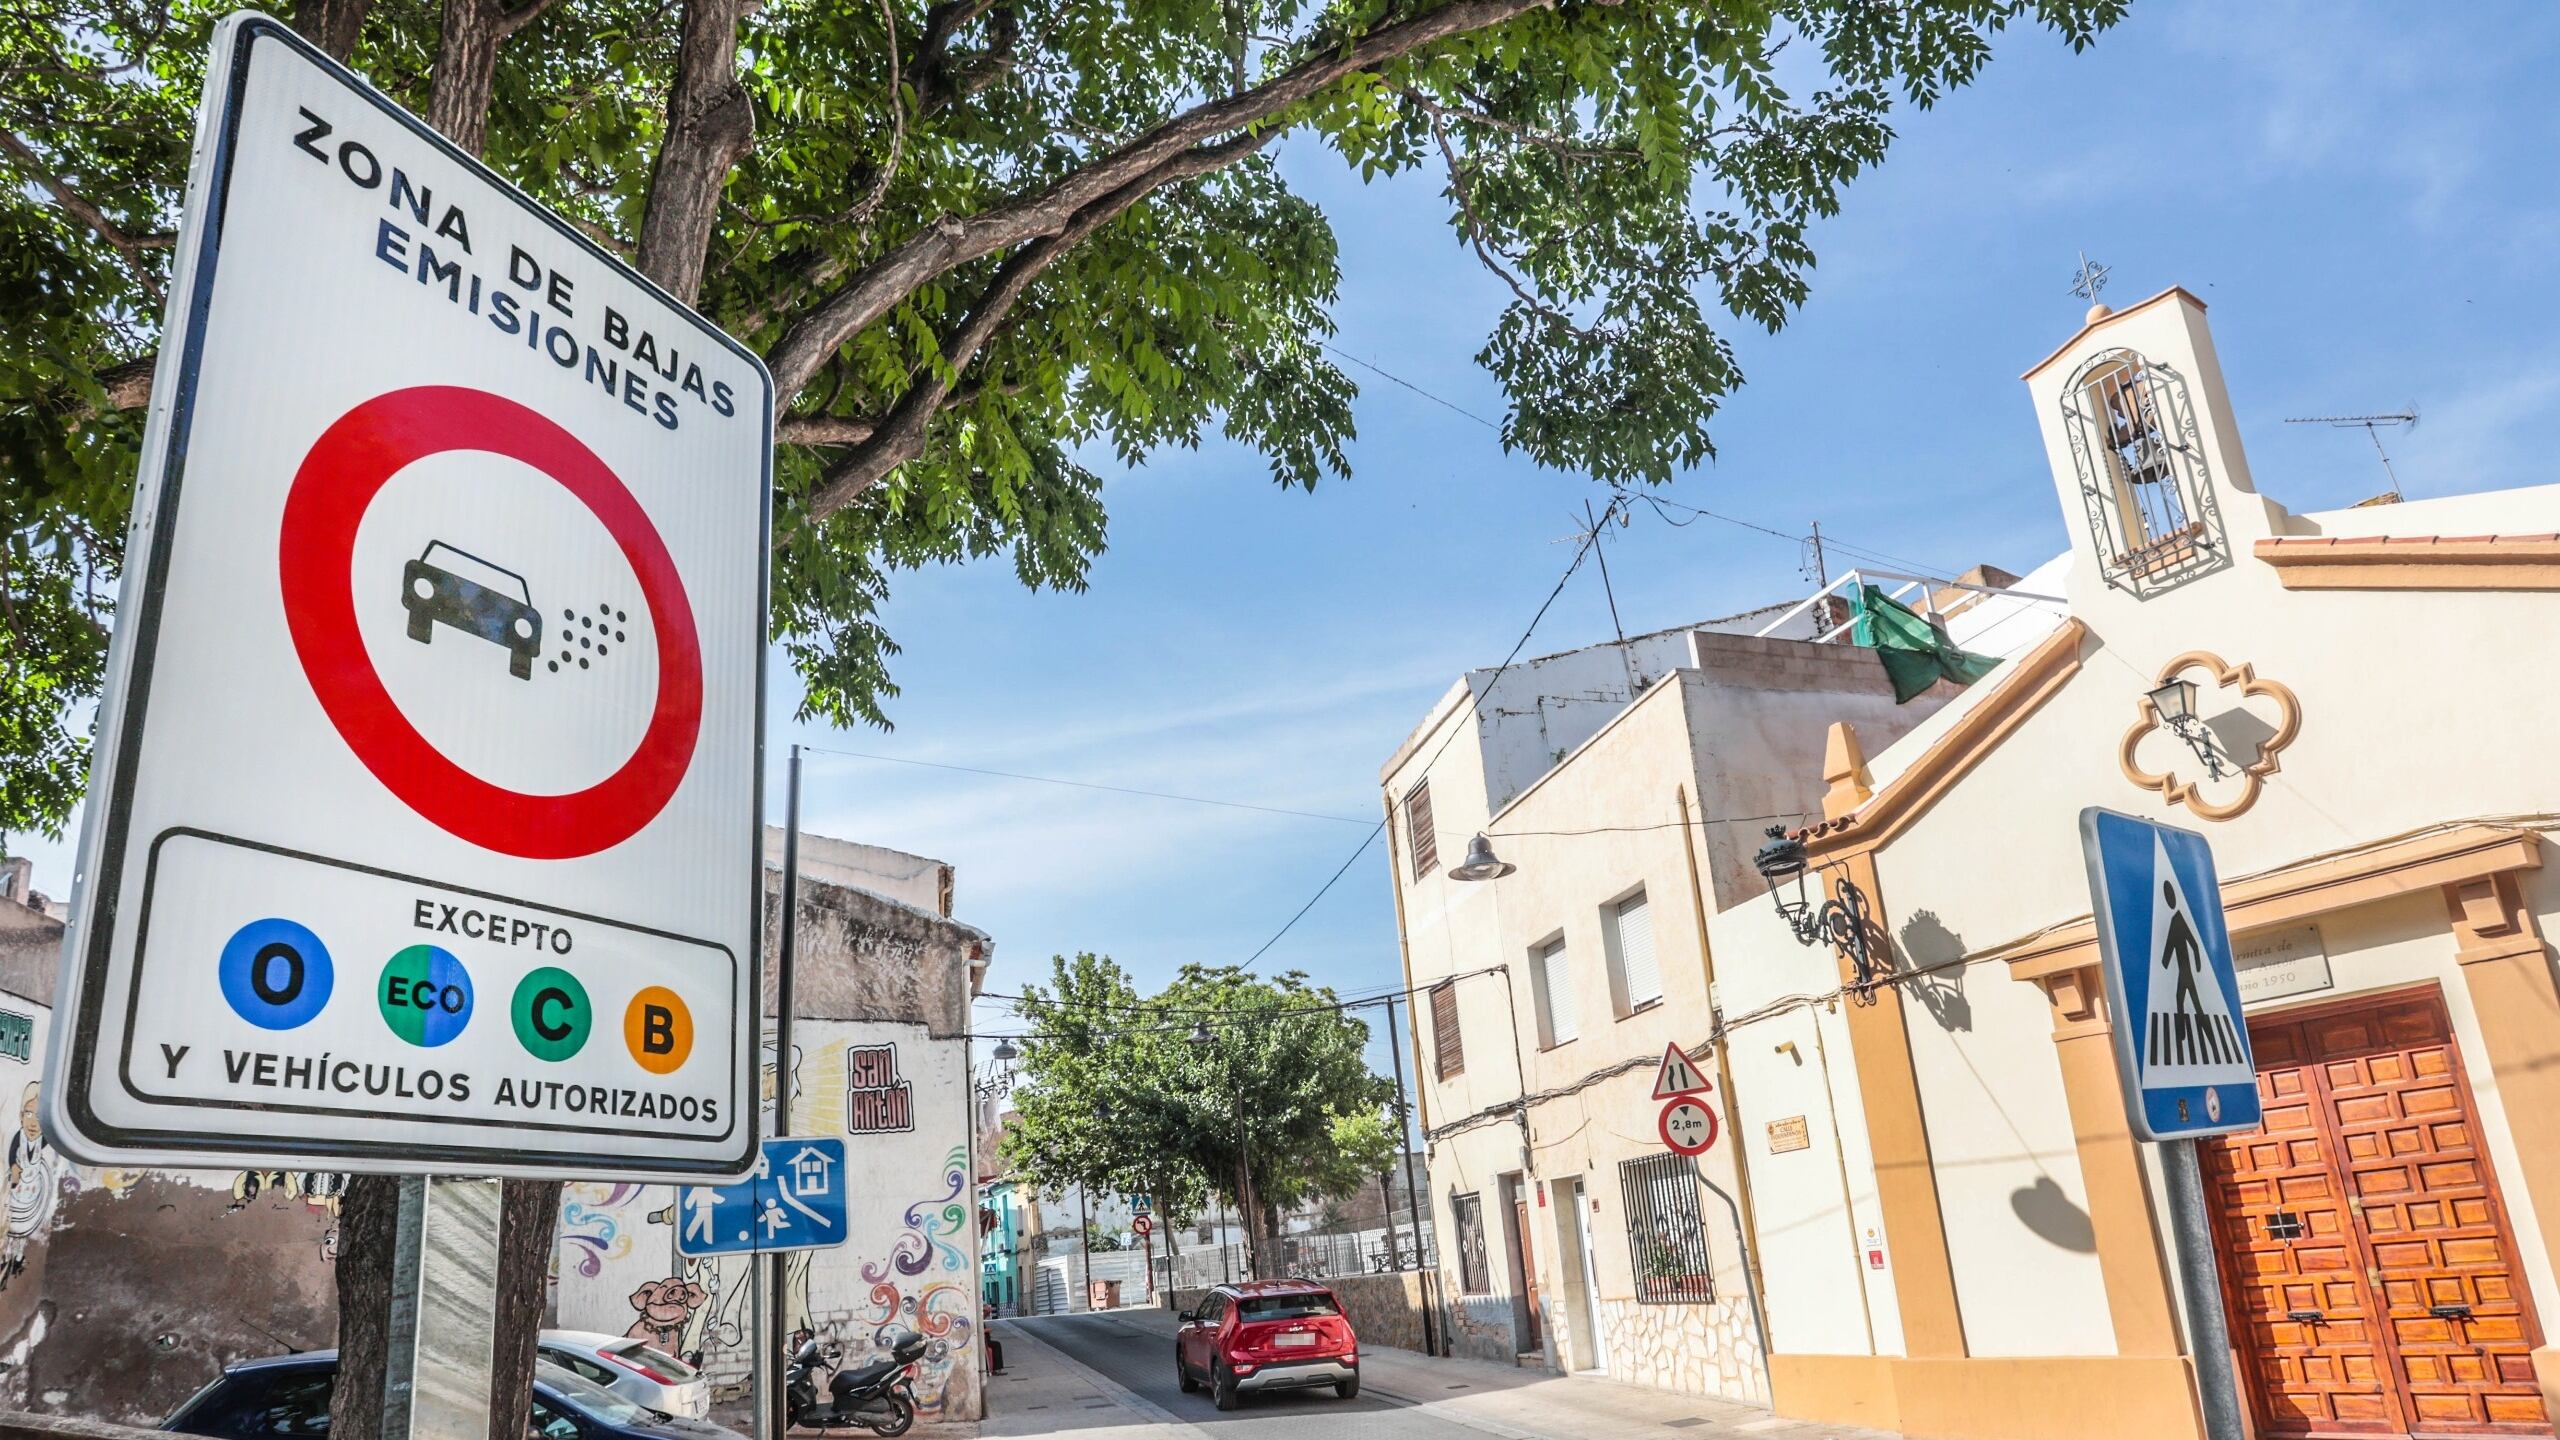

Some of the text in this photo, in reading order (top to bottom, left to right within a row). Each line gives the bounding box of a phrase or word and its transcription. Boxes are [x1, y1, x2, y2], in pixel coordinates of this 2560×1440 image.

[294, 105, 736, 419] ZONA DE BAJAS
[376, 216, 681, 431] EMISIONES
[413, 898, 573, 956] EXCEPTO
[2278, 939, 2293, 952] de
[387, 976, 466, 1015] ECO
[2263, 972, 2296, 987] 1950
[530, 986, 573, 1042] C
[642, 1003, 674, 1055] B
[159, 1043, 718, 1124] Y VEHÍCULOS AUTORIZADOS
[1672, 1119, 1702, 1132] 2,8m
